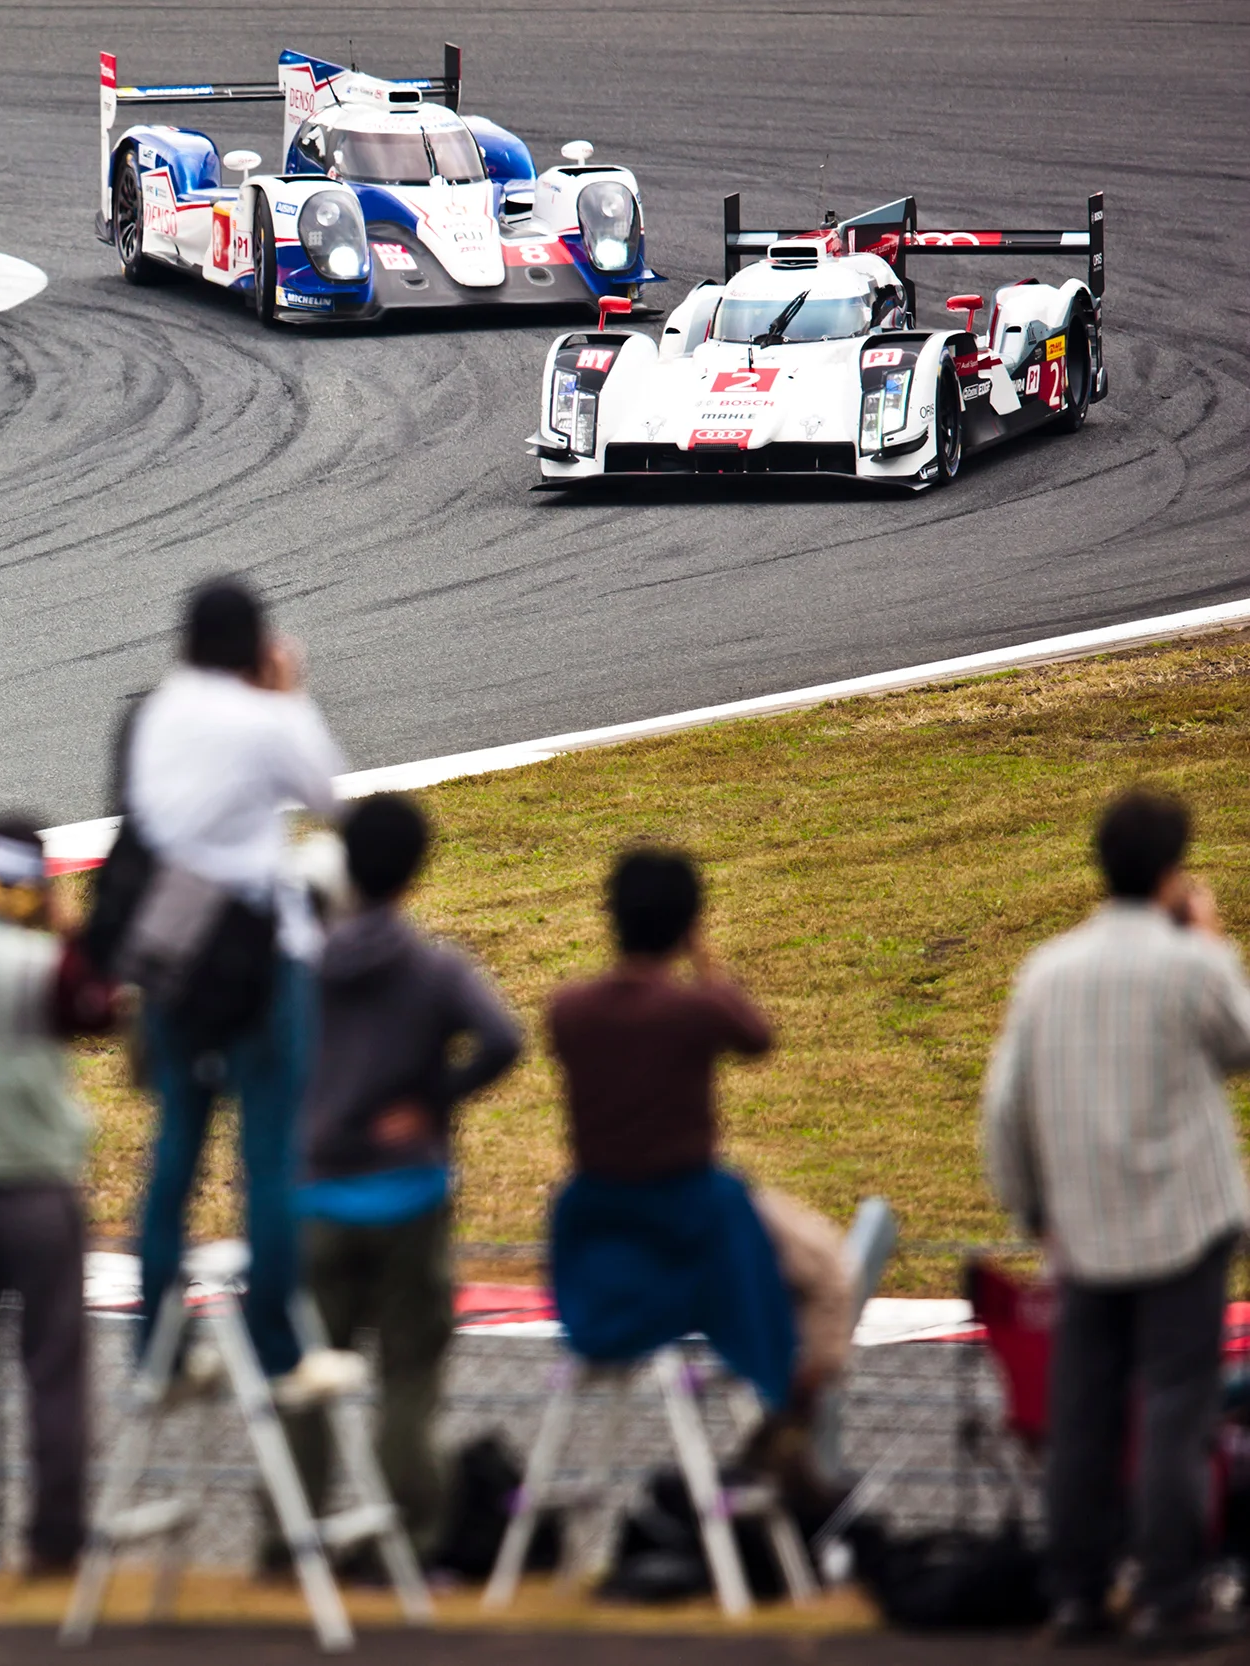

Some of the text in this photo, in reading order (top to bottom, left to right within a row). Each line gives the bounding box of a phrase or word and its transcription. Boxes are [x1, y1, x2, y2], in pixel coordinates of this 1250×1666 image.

[290, 87, 315, 113] DENSO
[276, 203, 297, 214] AISIN
[144, 202, 178, 236] DENSO
[213, 220, 223, 262] 8
[237, 236, 248, 258] P1
[387, 256, 410, 266] P1
[518, 244, 551, 263] 8
[1092, 252, 1103, 267] ORIS
[287, 293, 332, 307] MICHELIN
[579, 350, 611, 368] HY
[869, 351, 894, 363] P1
[961, 361, 970, 369] Audi
[724, 372, 761, 391] 2
[978, 380, 991, 396] EDGE
[1029, 370, 1039, 390] P1
[1049, 361, 1060, 406] 2
[919, 404, 935, 419] ORIS
